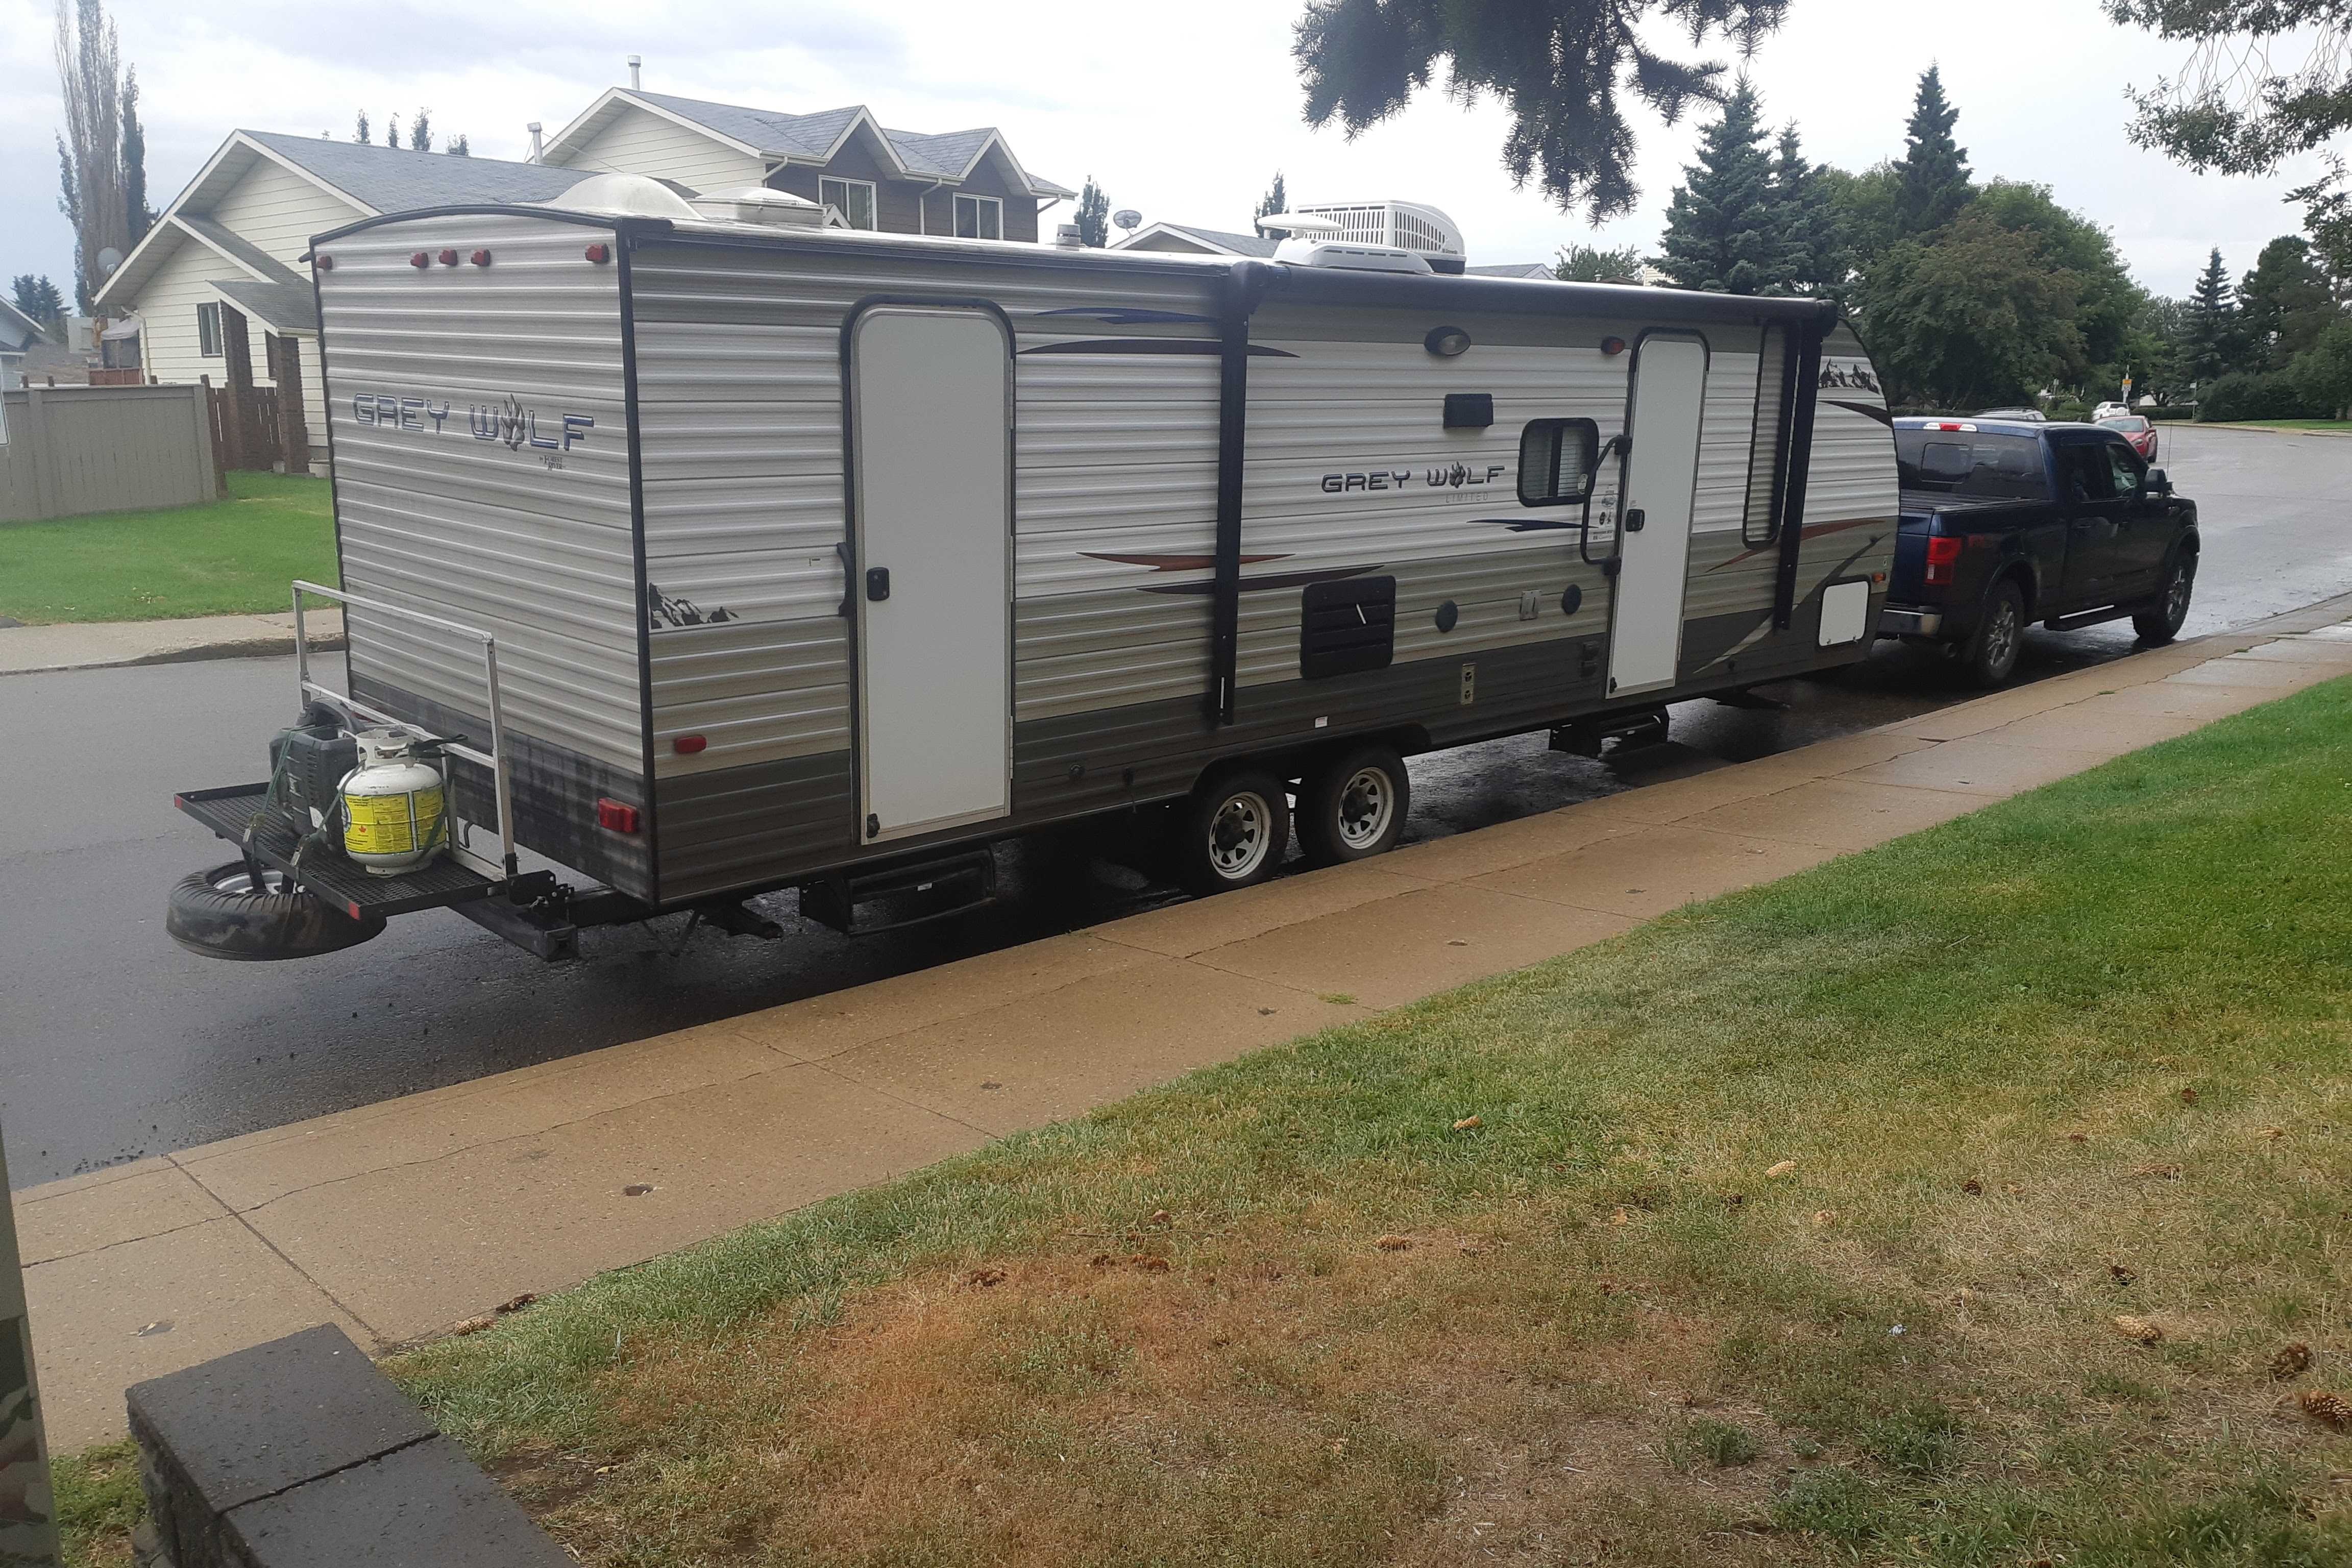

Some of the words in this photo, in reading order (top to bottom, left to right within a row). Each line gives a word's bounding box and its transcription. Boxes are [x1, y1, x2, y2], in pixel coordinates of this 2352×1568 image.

[353, 393, 450, 434] GREY
[1321, 470, 1411, 493] GREY
[1445, 491, 1489, 503] LIMITED
